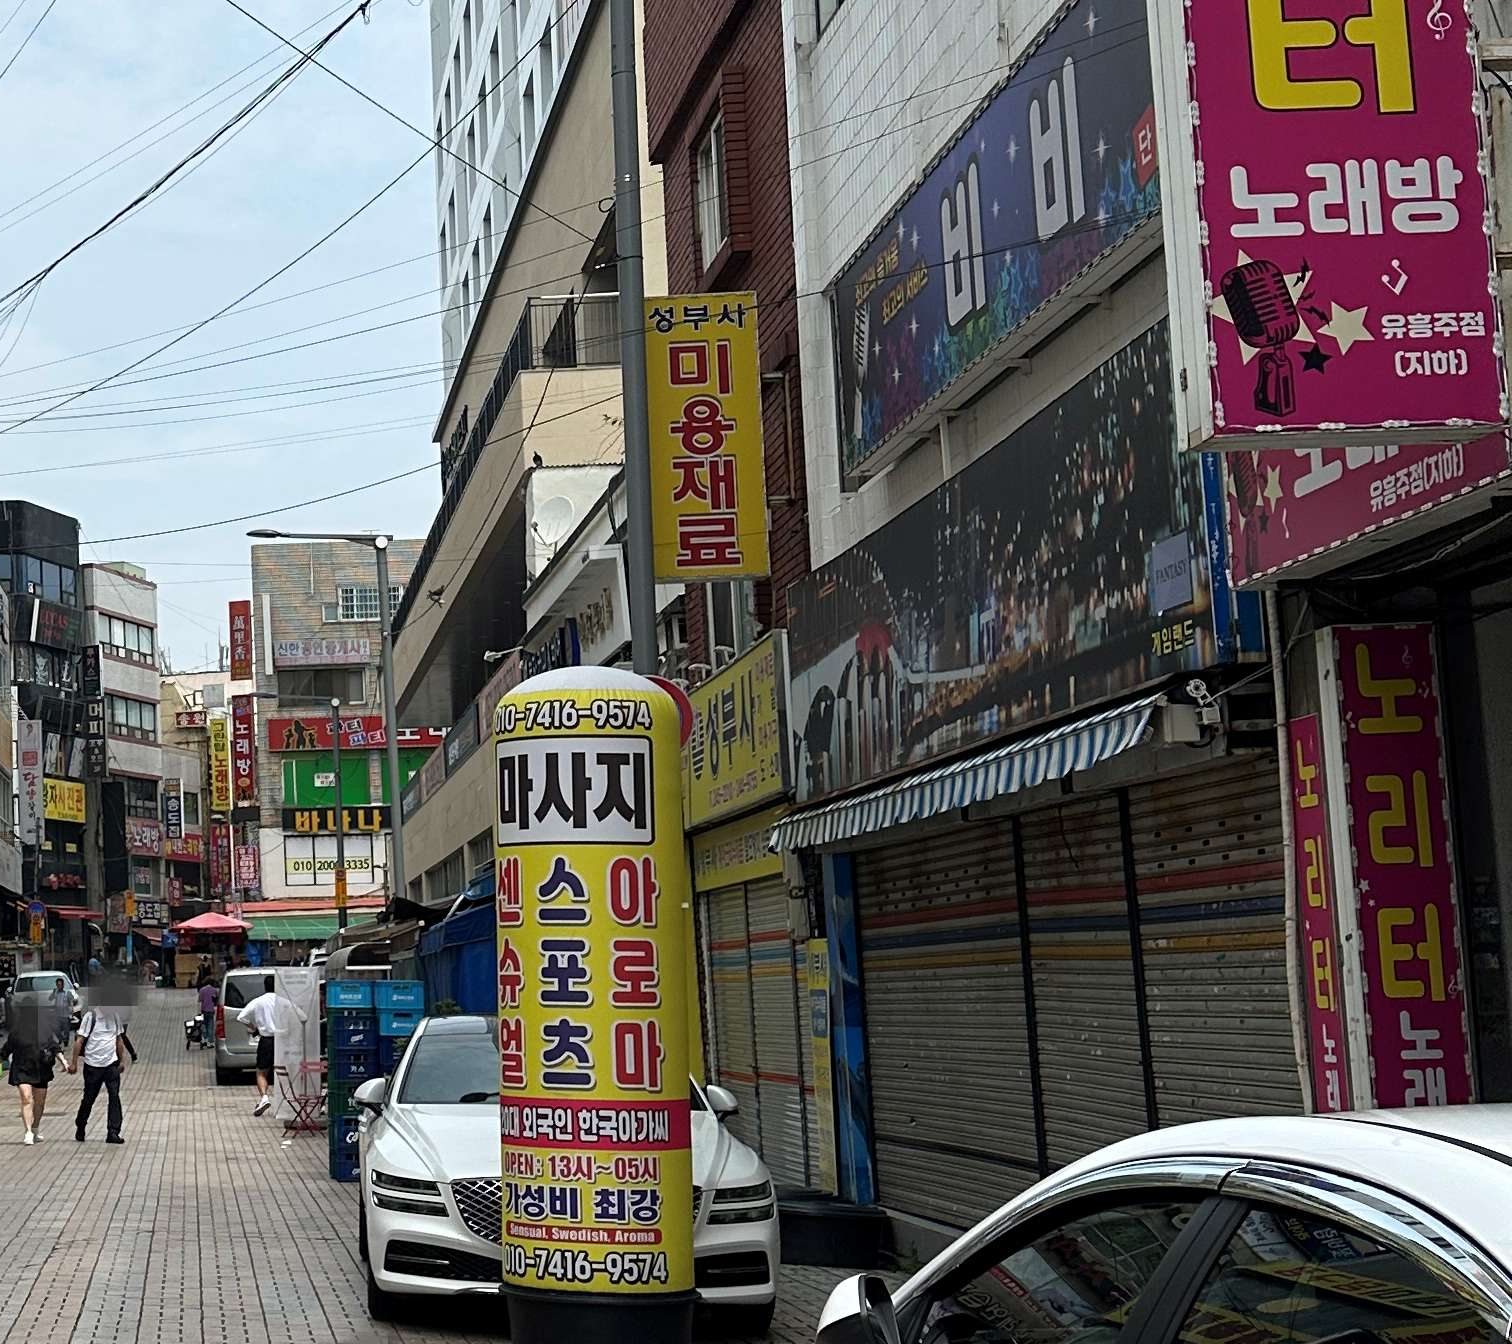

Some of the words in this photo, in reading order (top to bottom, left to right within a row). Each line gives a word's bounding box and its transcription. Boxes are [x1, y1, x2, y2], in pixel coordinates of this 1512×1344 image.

[1229, 155, 1464, 238] 노래방
[648, 303, 746, 333] 성부사
[1380, 312, 1486, 341] 유흥주점
[1393, 348, 1469, 378] (지하)
[669, 338, 743, 568] 미용재료
[1155, 558, 1188, 587] FANTASY
[1151, 618, 1196, 657] 게임랜드
[495, 700, 652, 734] 010-7416-9574
[235, 719, 252, 775] 노래방
[499, 751, 648, 831] 마사지
[294, 808, 383, 833] 바나나
[1354, 642, 1449, 1003] 노리터
[293, 861, 312, 871] 010
[345, 858, 370, 870] 3335
[1296, 737, 1336, 1013] 노리터
[536, 855, 596, 1087] 스포츠
[609, 855, 663, 1089] 아로마
[523, 1106, 573, 1142] 외국인
[578, 1108, 670, 1142] 한국아가씨
[506, 1181, 581, 1221] 가성비
[593, 1187, 660, 1225] 최강
[615, 1228, 656, 1244] Aroma
[503, 1242, 668, 1283] 010-7416-9574
